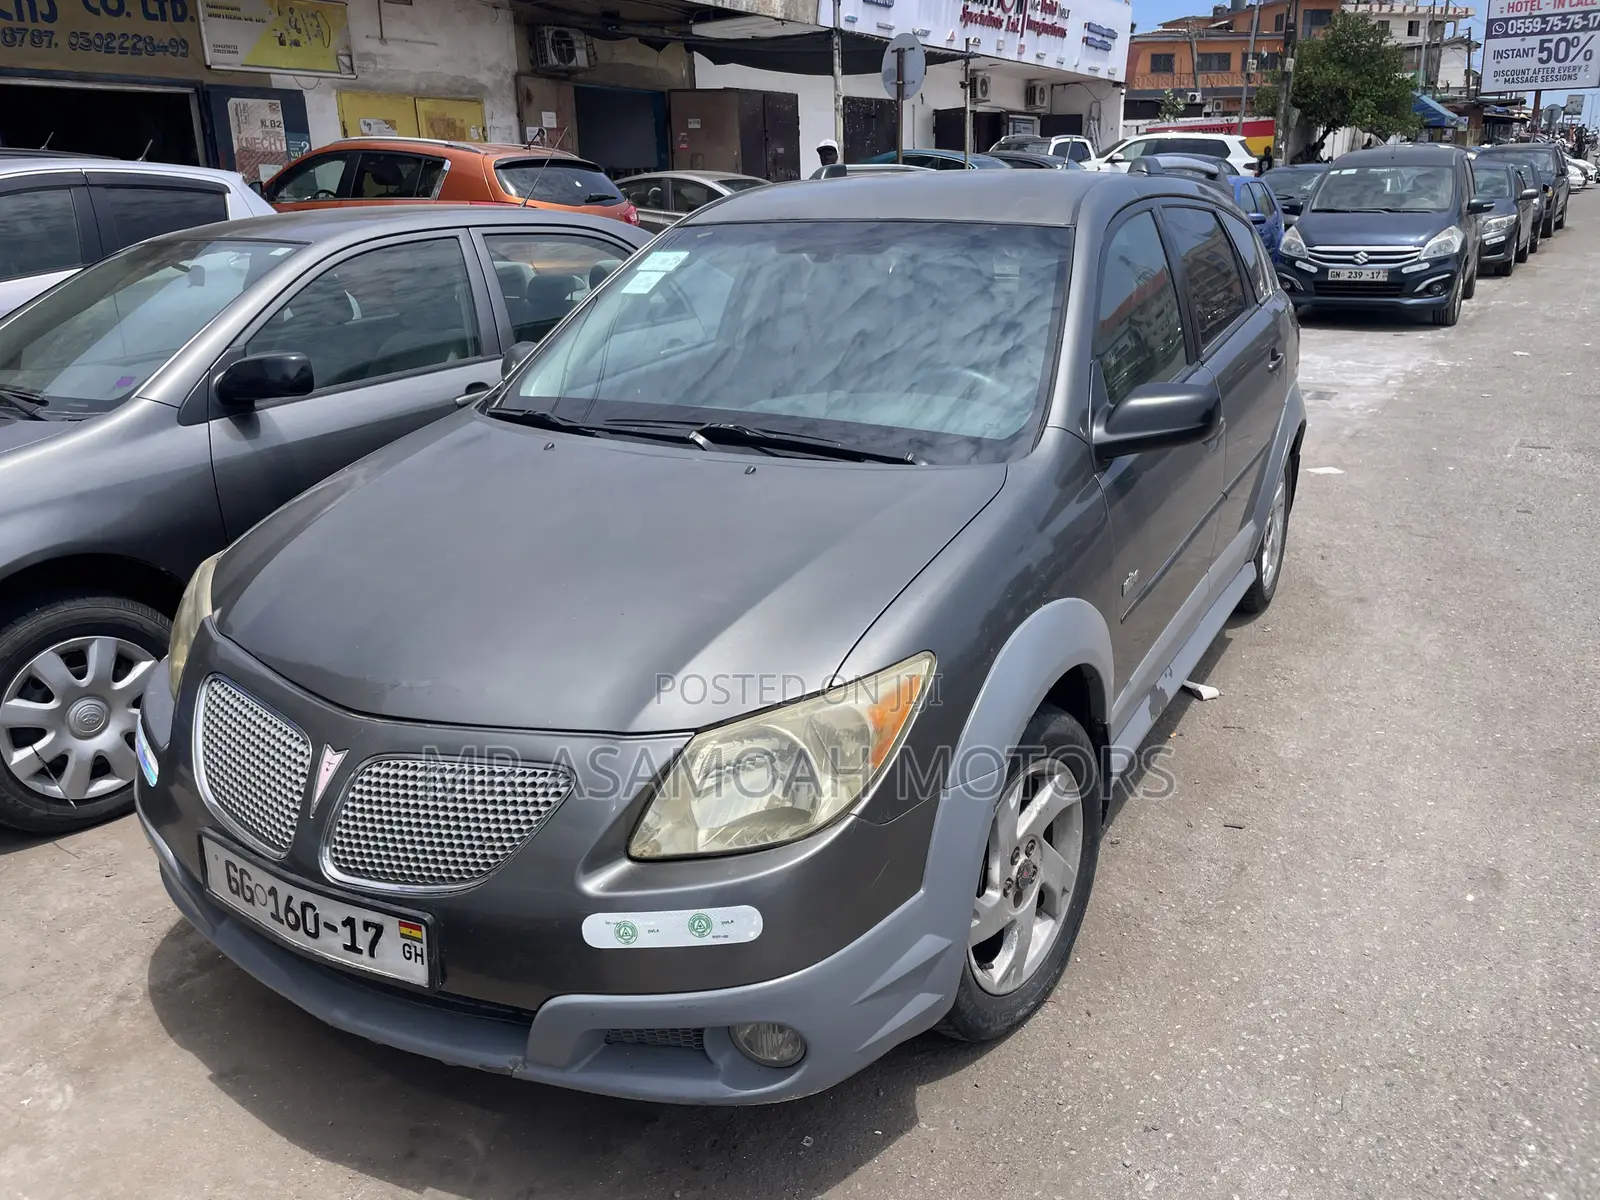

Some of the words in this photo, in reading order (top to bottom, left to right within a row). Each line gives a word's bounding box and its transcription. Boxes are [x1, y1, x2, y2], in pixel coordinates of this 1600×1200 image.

[1507, 1, 1543, 13] HOTEL
[1493, 47, 1536, 60] INSTANT
[1537, 34, 1596, 65] 50%
[1493, 69, 1530, 78] DISCOUNT
[1533, 67, 1555, 75] AFTER
[1558, 65, 1582, 73] EVERY
[1503, 76, 1539, 84] MASSAGE
[1541, 74, 1578, 82] SESSIONS
[236, 136, 285, 152] KNECHT
[267, 886, 385, 959] 160-17
[402, 942, 425, 966] GH
